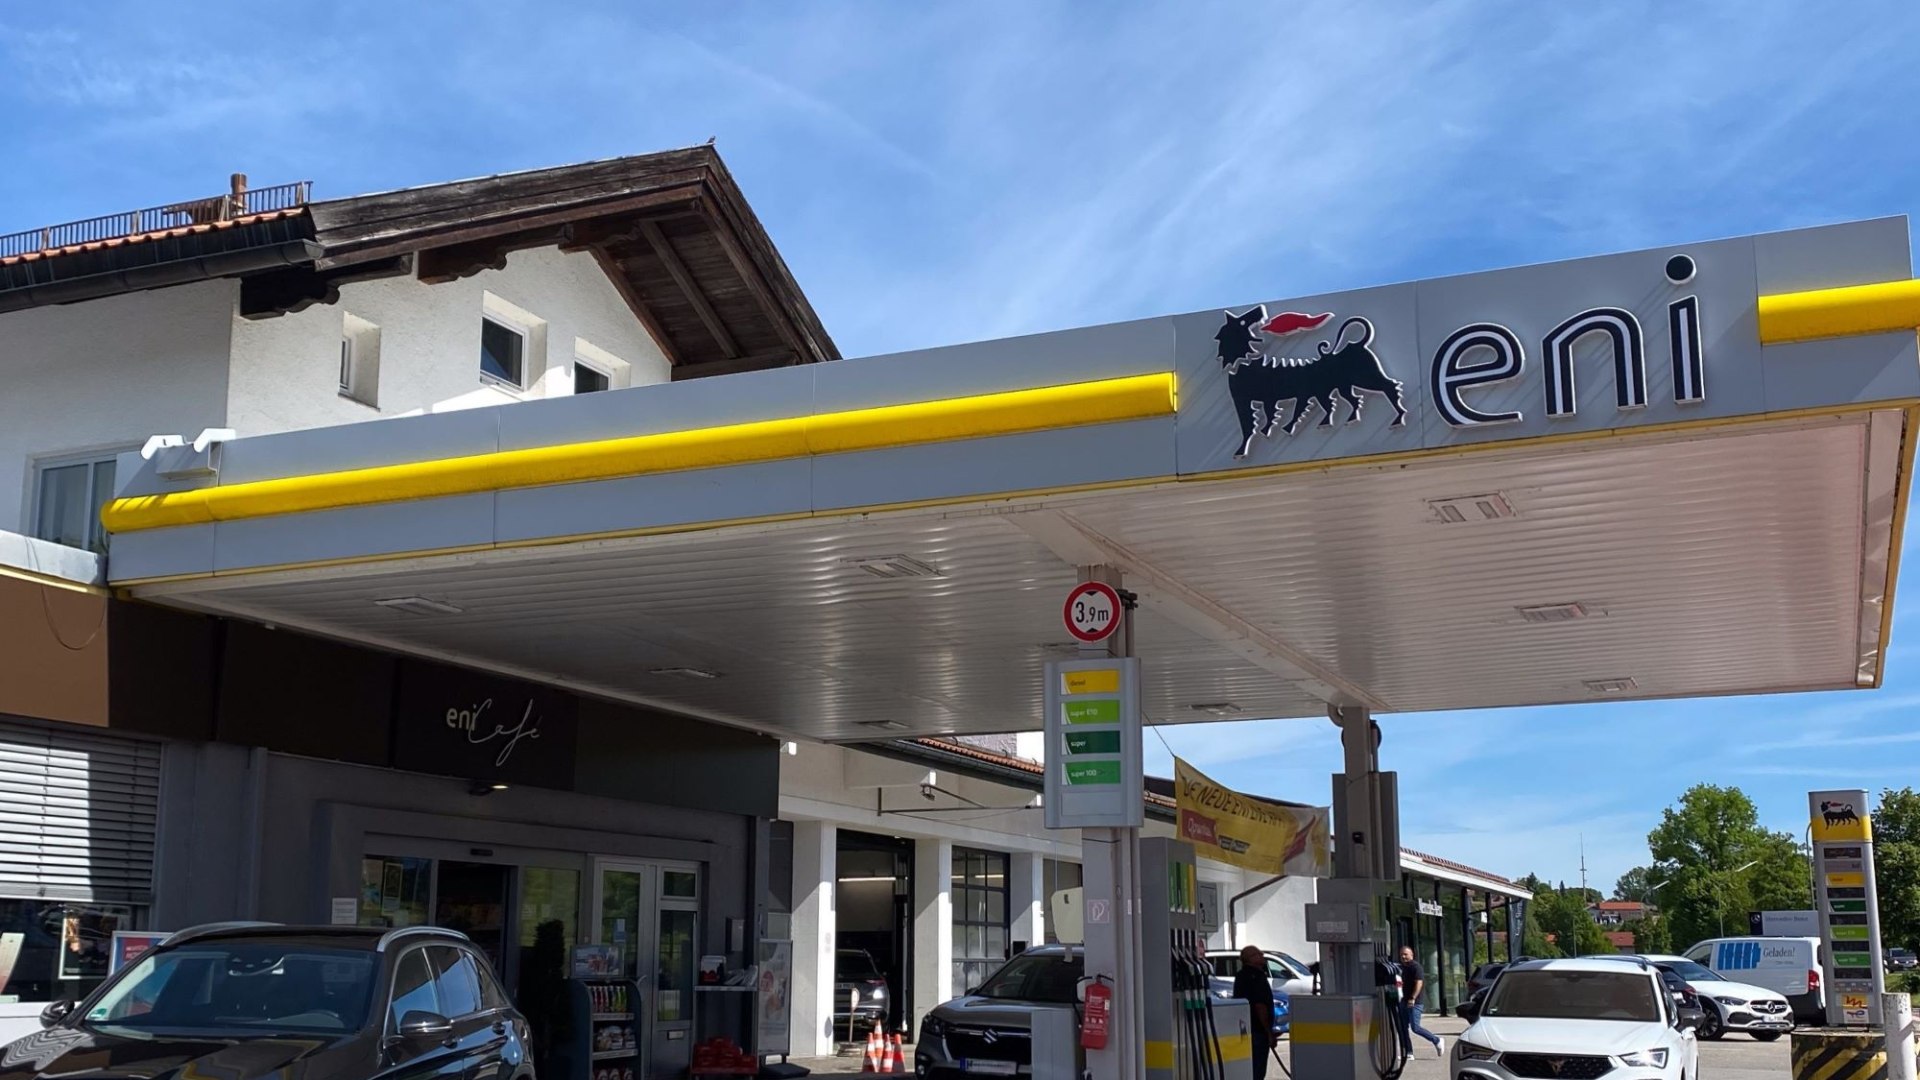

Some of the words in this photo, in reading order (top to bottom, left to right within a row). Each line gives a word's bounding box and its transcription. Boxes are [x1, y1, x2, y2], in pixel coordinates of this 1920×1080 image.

[1430, 253, 1705, 428] eni
[1070, 740, 1086, 748] super
[1085, 769, 1097, 777] 100
[1197, 784, 1232, 812] NEUE
[1763, 946, 1796, 957] Geladen!
